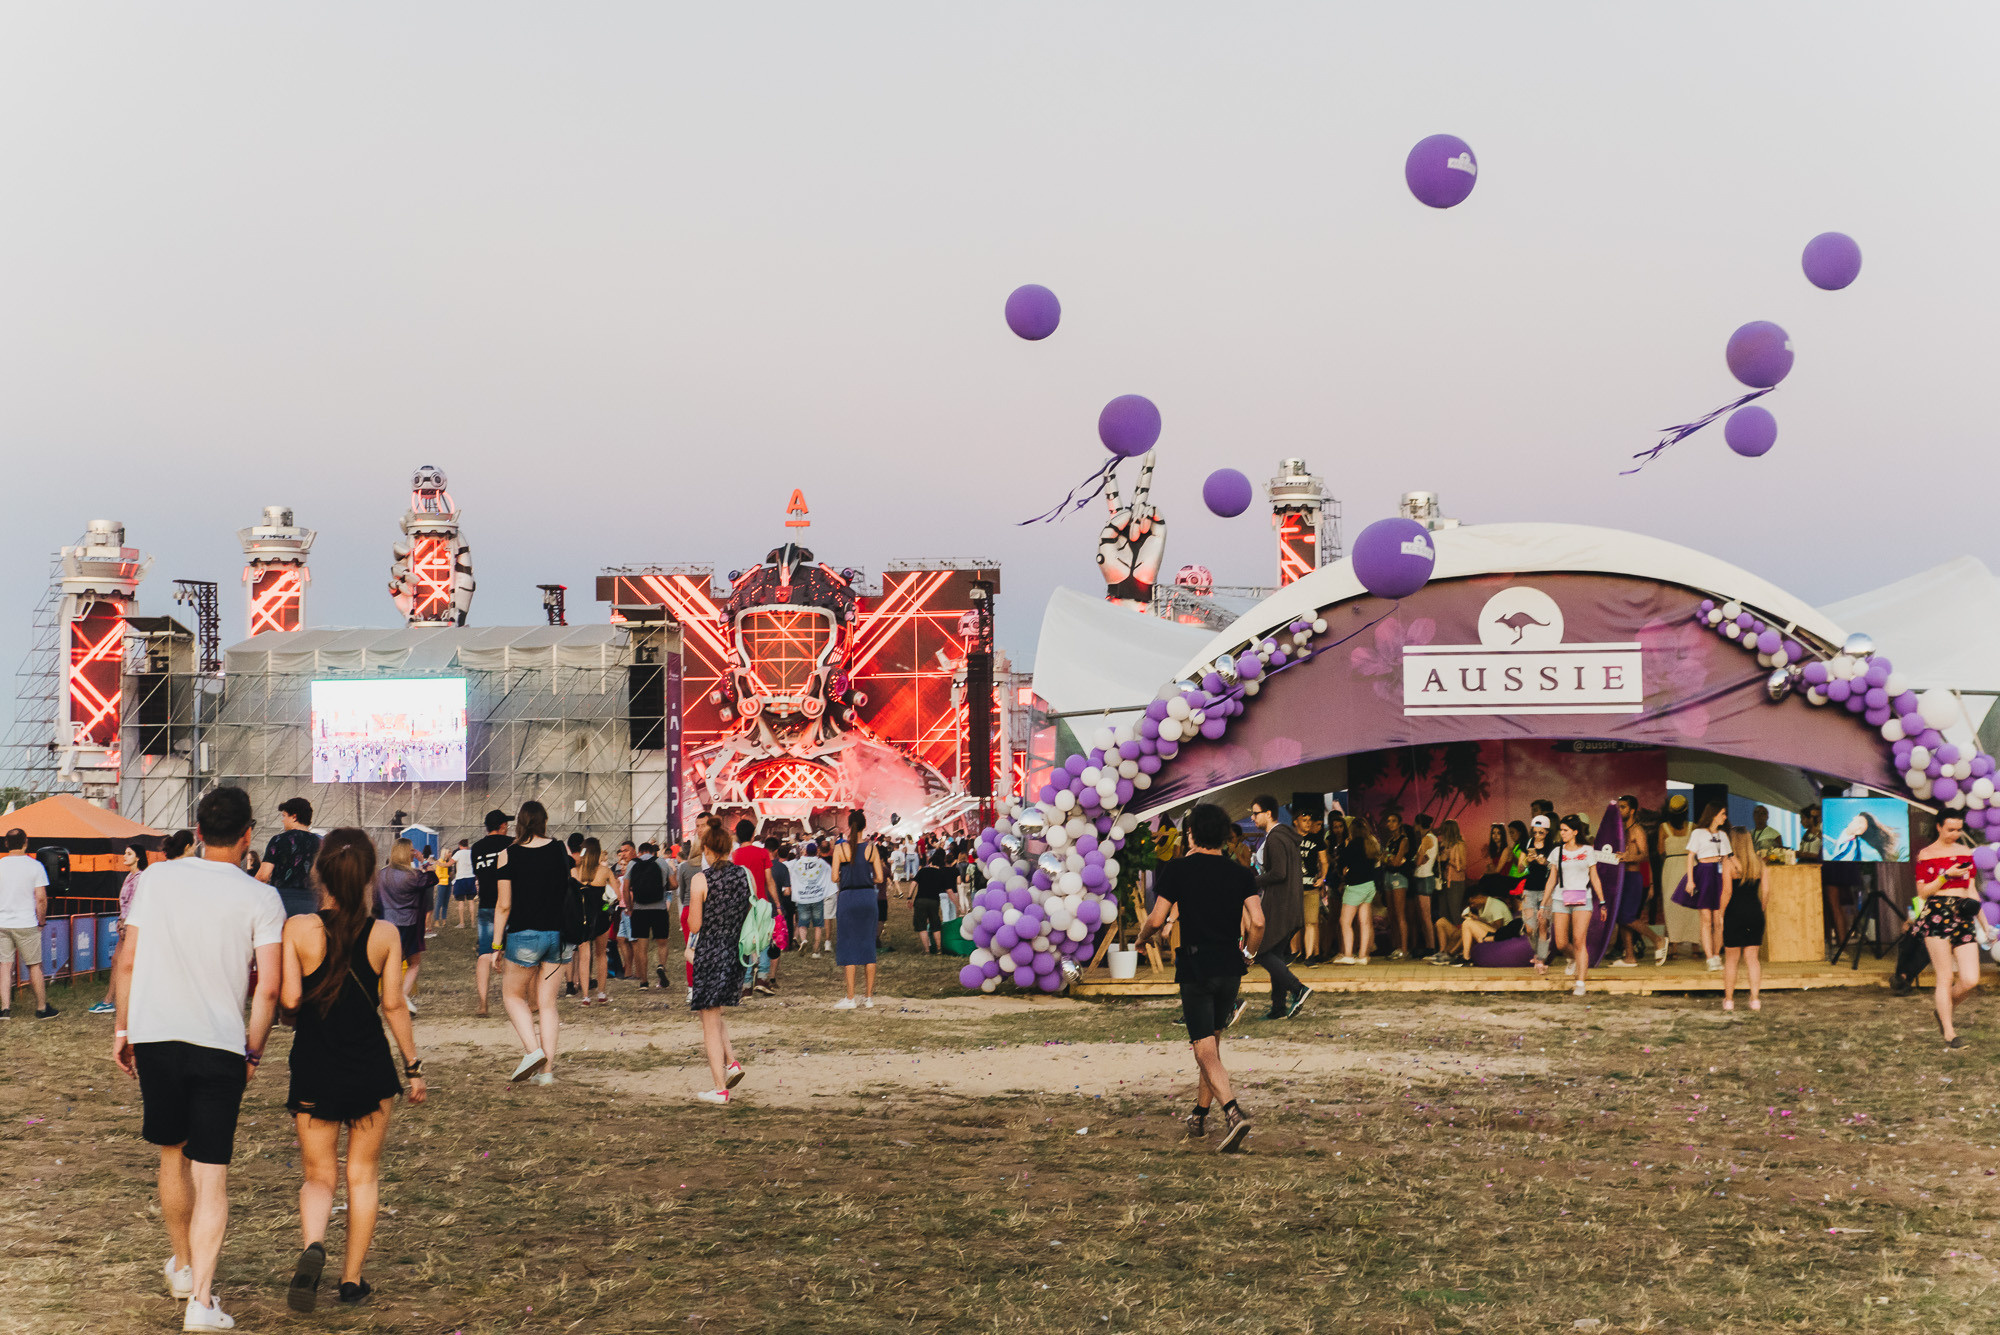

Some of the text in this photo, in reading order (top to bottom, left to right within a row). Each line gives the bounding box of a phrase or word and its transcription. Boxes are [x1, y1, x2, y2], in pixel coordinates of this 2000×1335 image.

[786, 488, 809, 514] A
[1421, 666, 1625, 693] AUSSIE
[476, 852, 500, 870] AF
